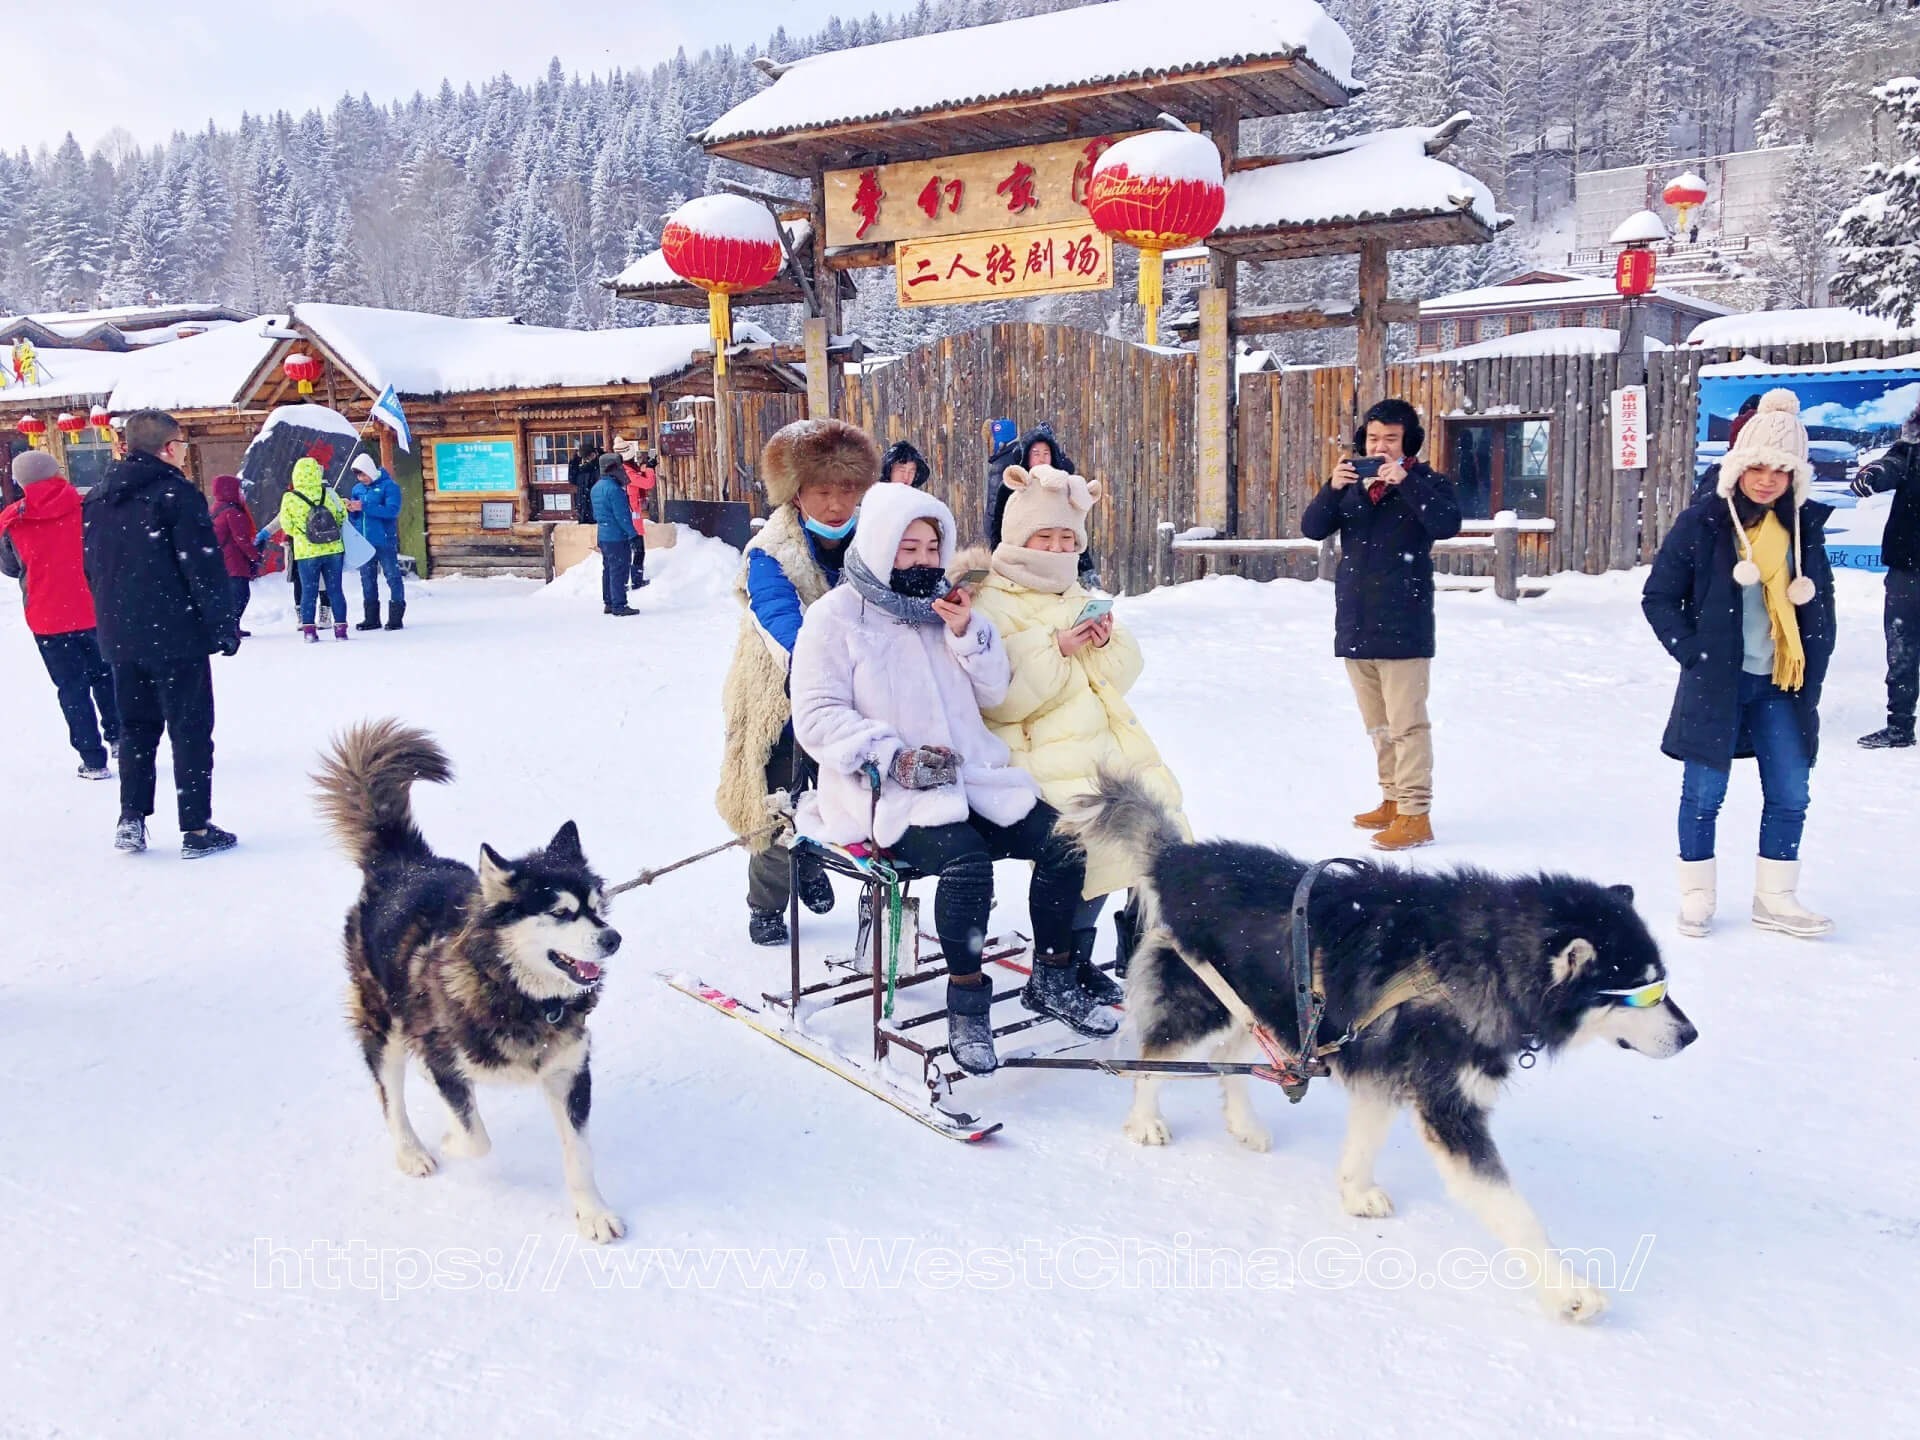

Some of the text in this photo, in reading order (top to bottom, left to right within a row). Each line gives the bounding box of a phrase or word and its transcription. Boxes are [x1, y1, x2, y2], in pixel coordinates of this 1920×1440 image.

[908, 234, 1101, 287] 二人转剧场
[1829, 549, 1849, 567] 政
